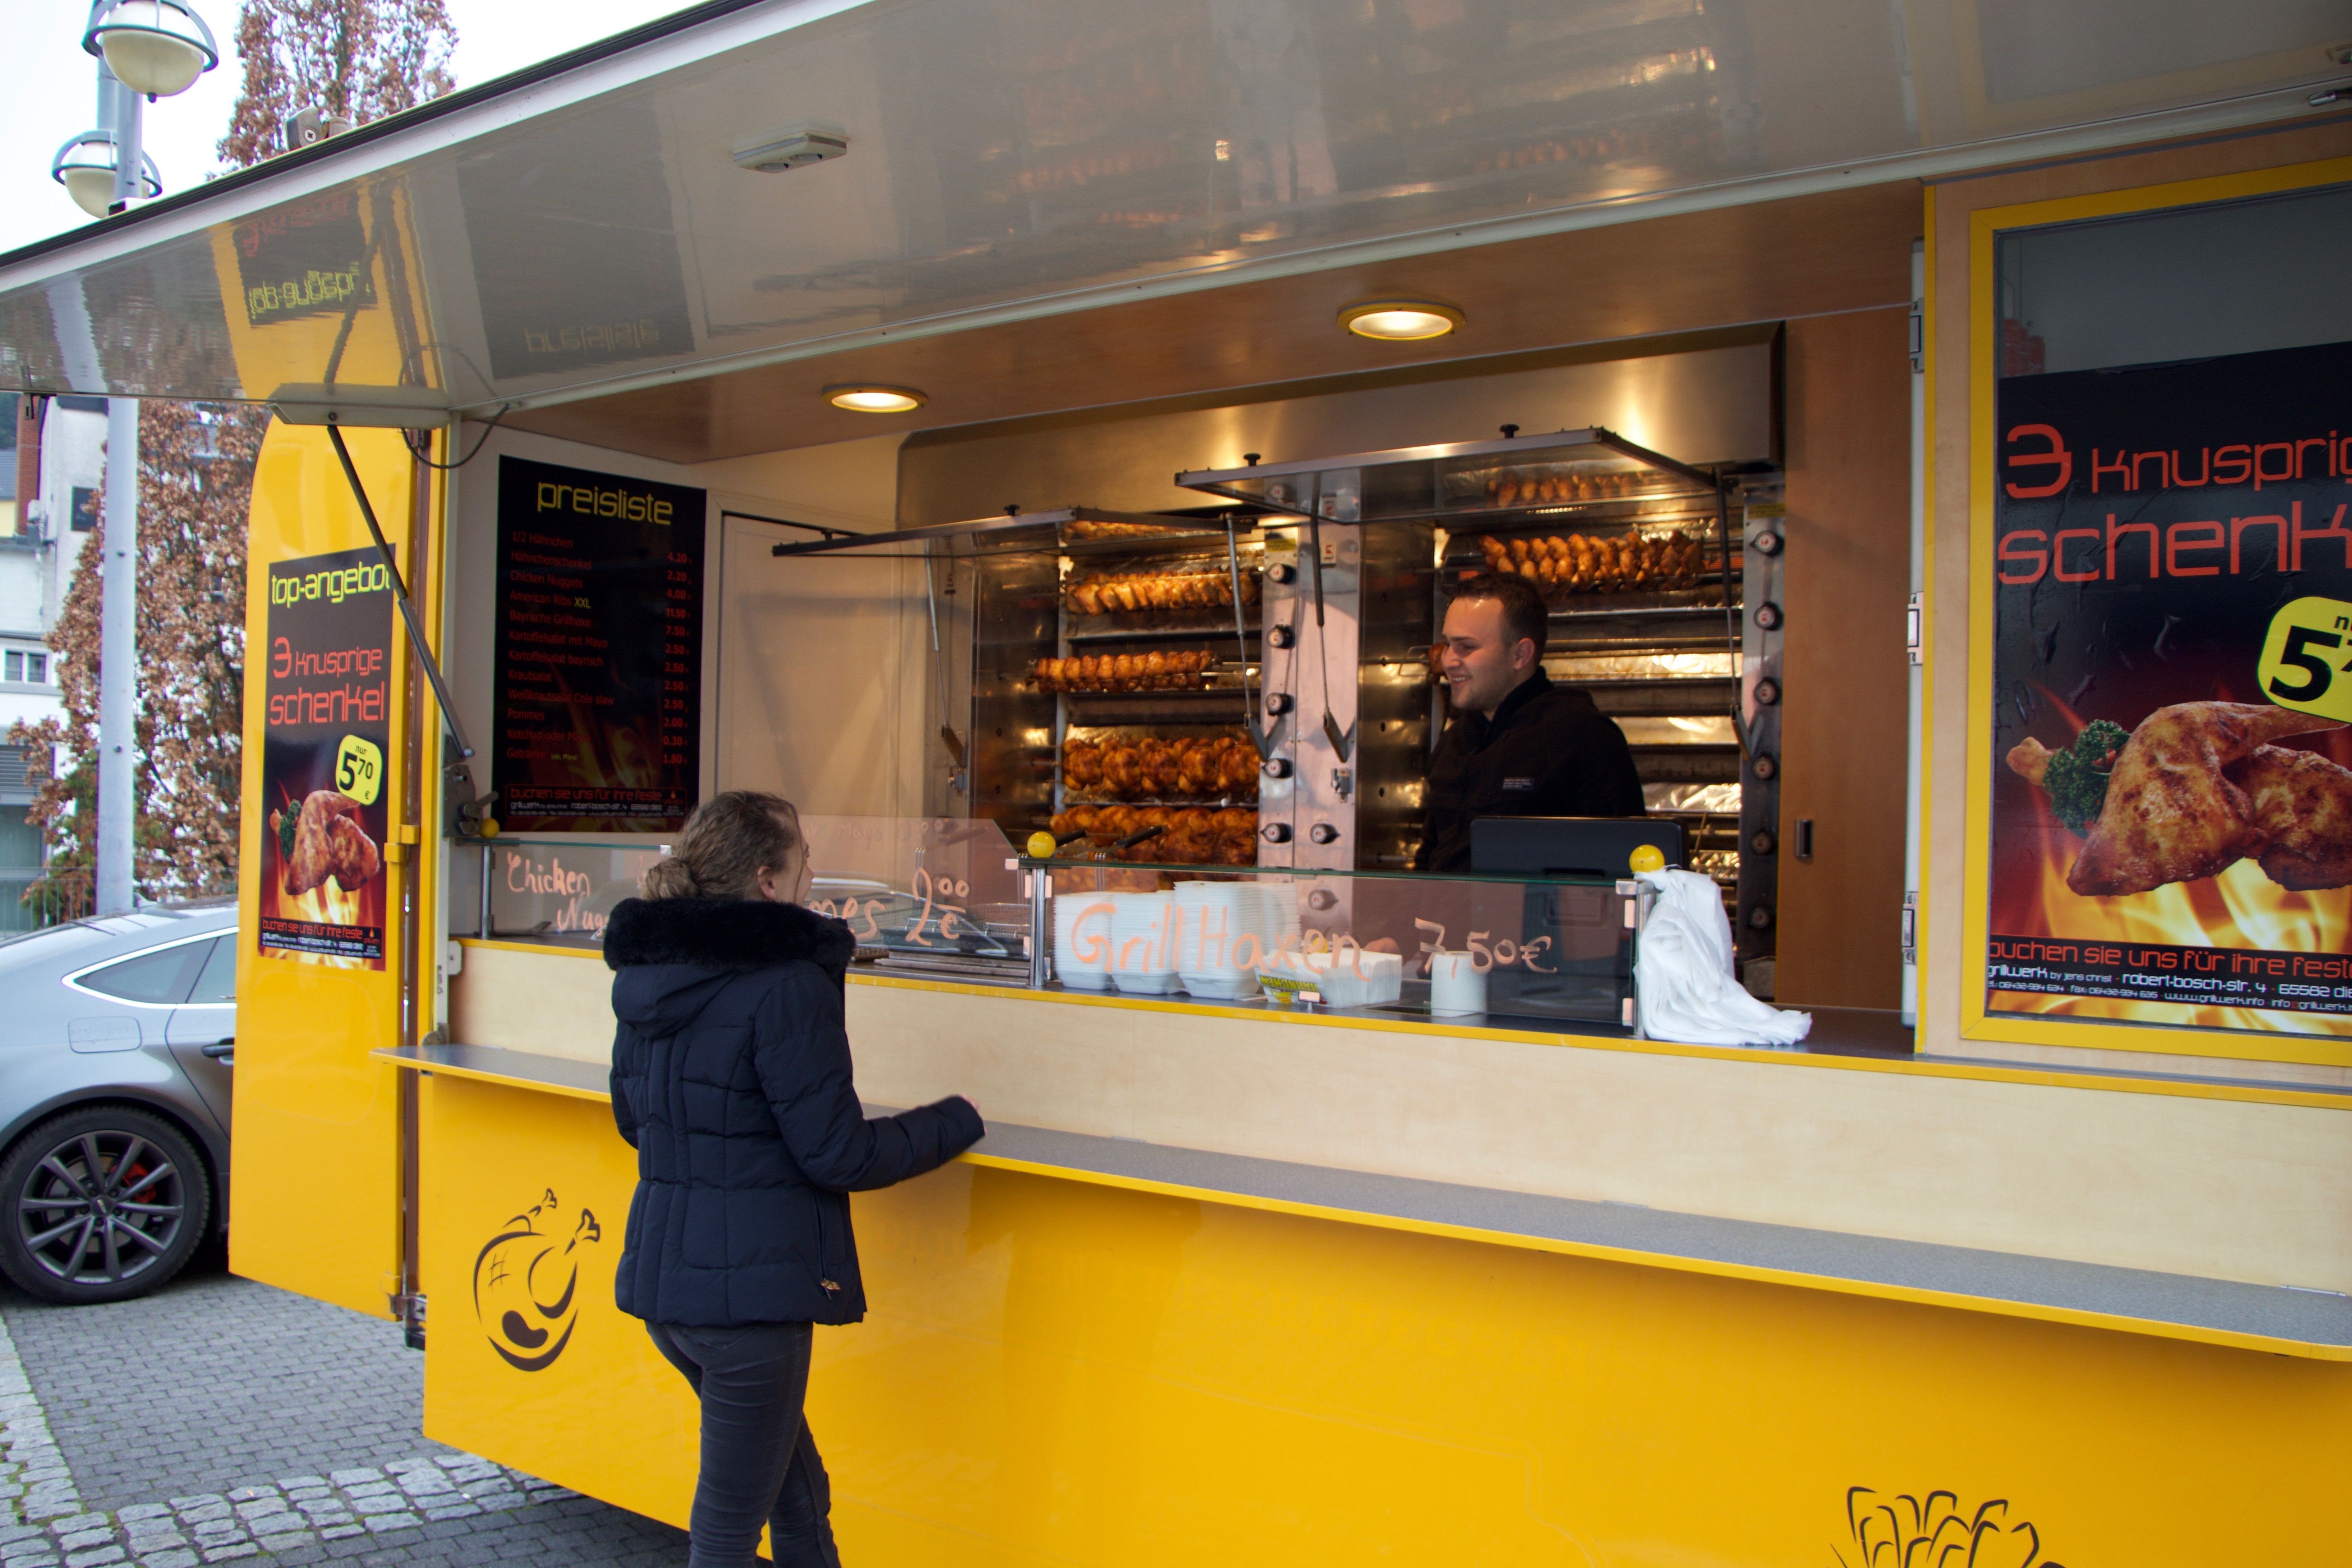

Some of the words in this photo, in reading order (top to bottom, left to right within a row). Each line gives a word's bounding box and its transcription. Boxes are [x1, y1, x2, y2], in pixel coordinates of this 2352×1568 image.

[2006, 423, 2072, 499] 3
[537, 482, 673, 526] preisliste
[512, 530, 526, 543] 1/2
[529, 533, 573, 548] Hähnchen
[511, 550, 592, 570] Hähnchenschenkel
[667, 552, 687, 563] 4.20
[510, 570, 545, 584] Chicken
[547, 575, 583, 589] Nuggets
[667, 570, 687, 582] 2.20
[510, 590, 551, 603] American
[553, 594, 572, 606] Ribs
[574, 596, 592, 609] XXL
[666, 589, 686, 600] 4.00
[510, 609, 551, 623] Bayrische
[554, 613, 592, 628] Grillhaxe
[665, 625, 685, 637] 7.50
[509, 629, 566, 645] Kartoffelsalat
[569, 635, 582, 646] mit
[585, 636, 608, 649] Mayo
[665, 644, 685, 655] 2.50
[273, 637, 292, 678] 3
[296, 646, 382, 678] knusprige
[509, 649, 566, 664] Kartoffelsalat
[568, 653, 604, 667] bayrisch
[508, 668, 552, 682] Krautsalat
[665, 662, 684, 673] 2.50
[664, 680, 684, 691] 2.50
[270, 681, 385, 725] schenkel
[508, 688, 571, 702] Weißkrautsalat
[574, 693, 593, 704] Cole
[595, 694, 614, 705] slaw
[664, 699, 684, 710] 2.50
[508, 708, 545, 721] Pommes
[664, 717, 683, 728] 2.00
[507, 728, 542, 740] Ketchup
[546, 731, 564, 741] oder
[568, 731, 590, 742] Mayo
[663, 735, 682, 746] 0.30
[355, 745, 367, 755] nur
[507, 747, 547, 760] Getränke
[662, 753, 682, 764] 1.80
[511, 787, 552, 799] buchen
[555, 789, 571, 799] sie
[573, 789, 593, 800] uns
[595, 788, 611, 800] für
[613, 789, 633, 800] ihre
[635, 790, 662, 801] feste
[557, 891, 610, 938] Nug
[263, 918, 287, 931] buchen
[288, 922, 298, 933] sie
[299, 924, 313, 935] uns
[314, 924, 325, 936] für
[326, 926, 341, 938] ihre
[342, 927, 363, 940] feste
[1071, 903, 1182, 973] Grill
[1196, 906, 1370, 980] Haxen
[2084, 945, 2122, 965] sie
[2129, 949, 2178, 969] uns
[2184, 950, 2225, 971] für
[2232, 953, 2286, 976] ihre
[2293, 956, 2352, 979] fest
[1988, 964, 2048, 979] grillwerk
[2049, 971, 2062, 981] by
[2063, 972, 2085, 982] jens
[2255, 982, 2267, 994] 4
[2278, 984, 2331, 998] 65582
